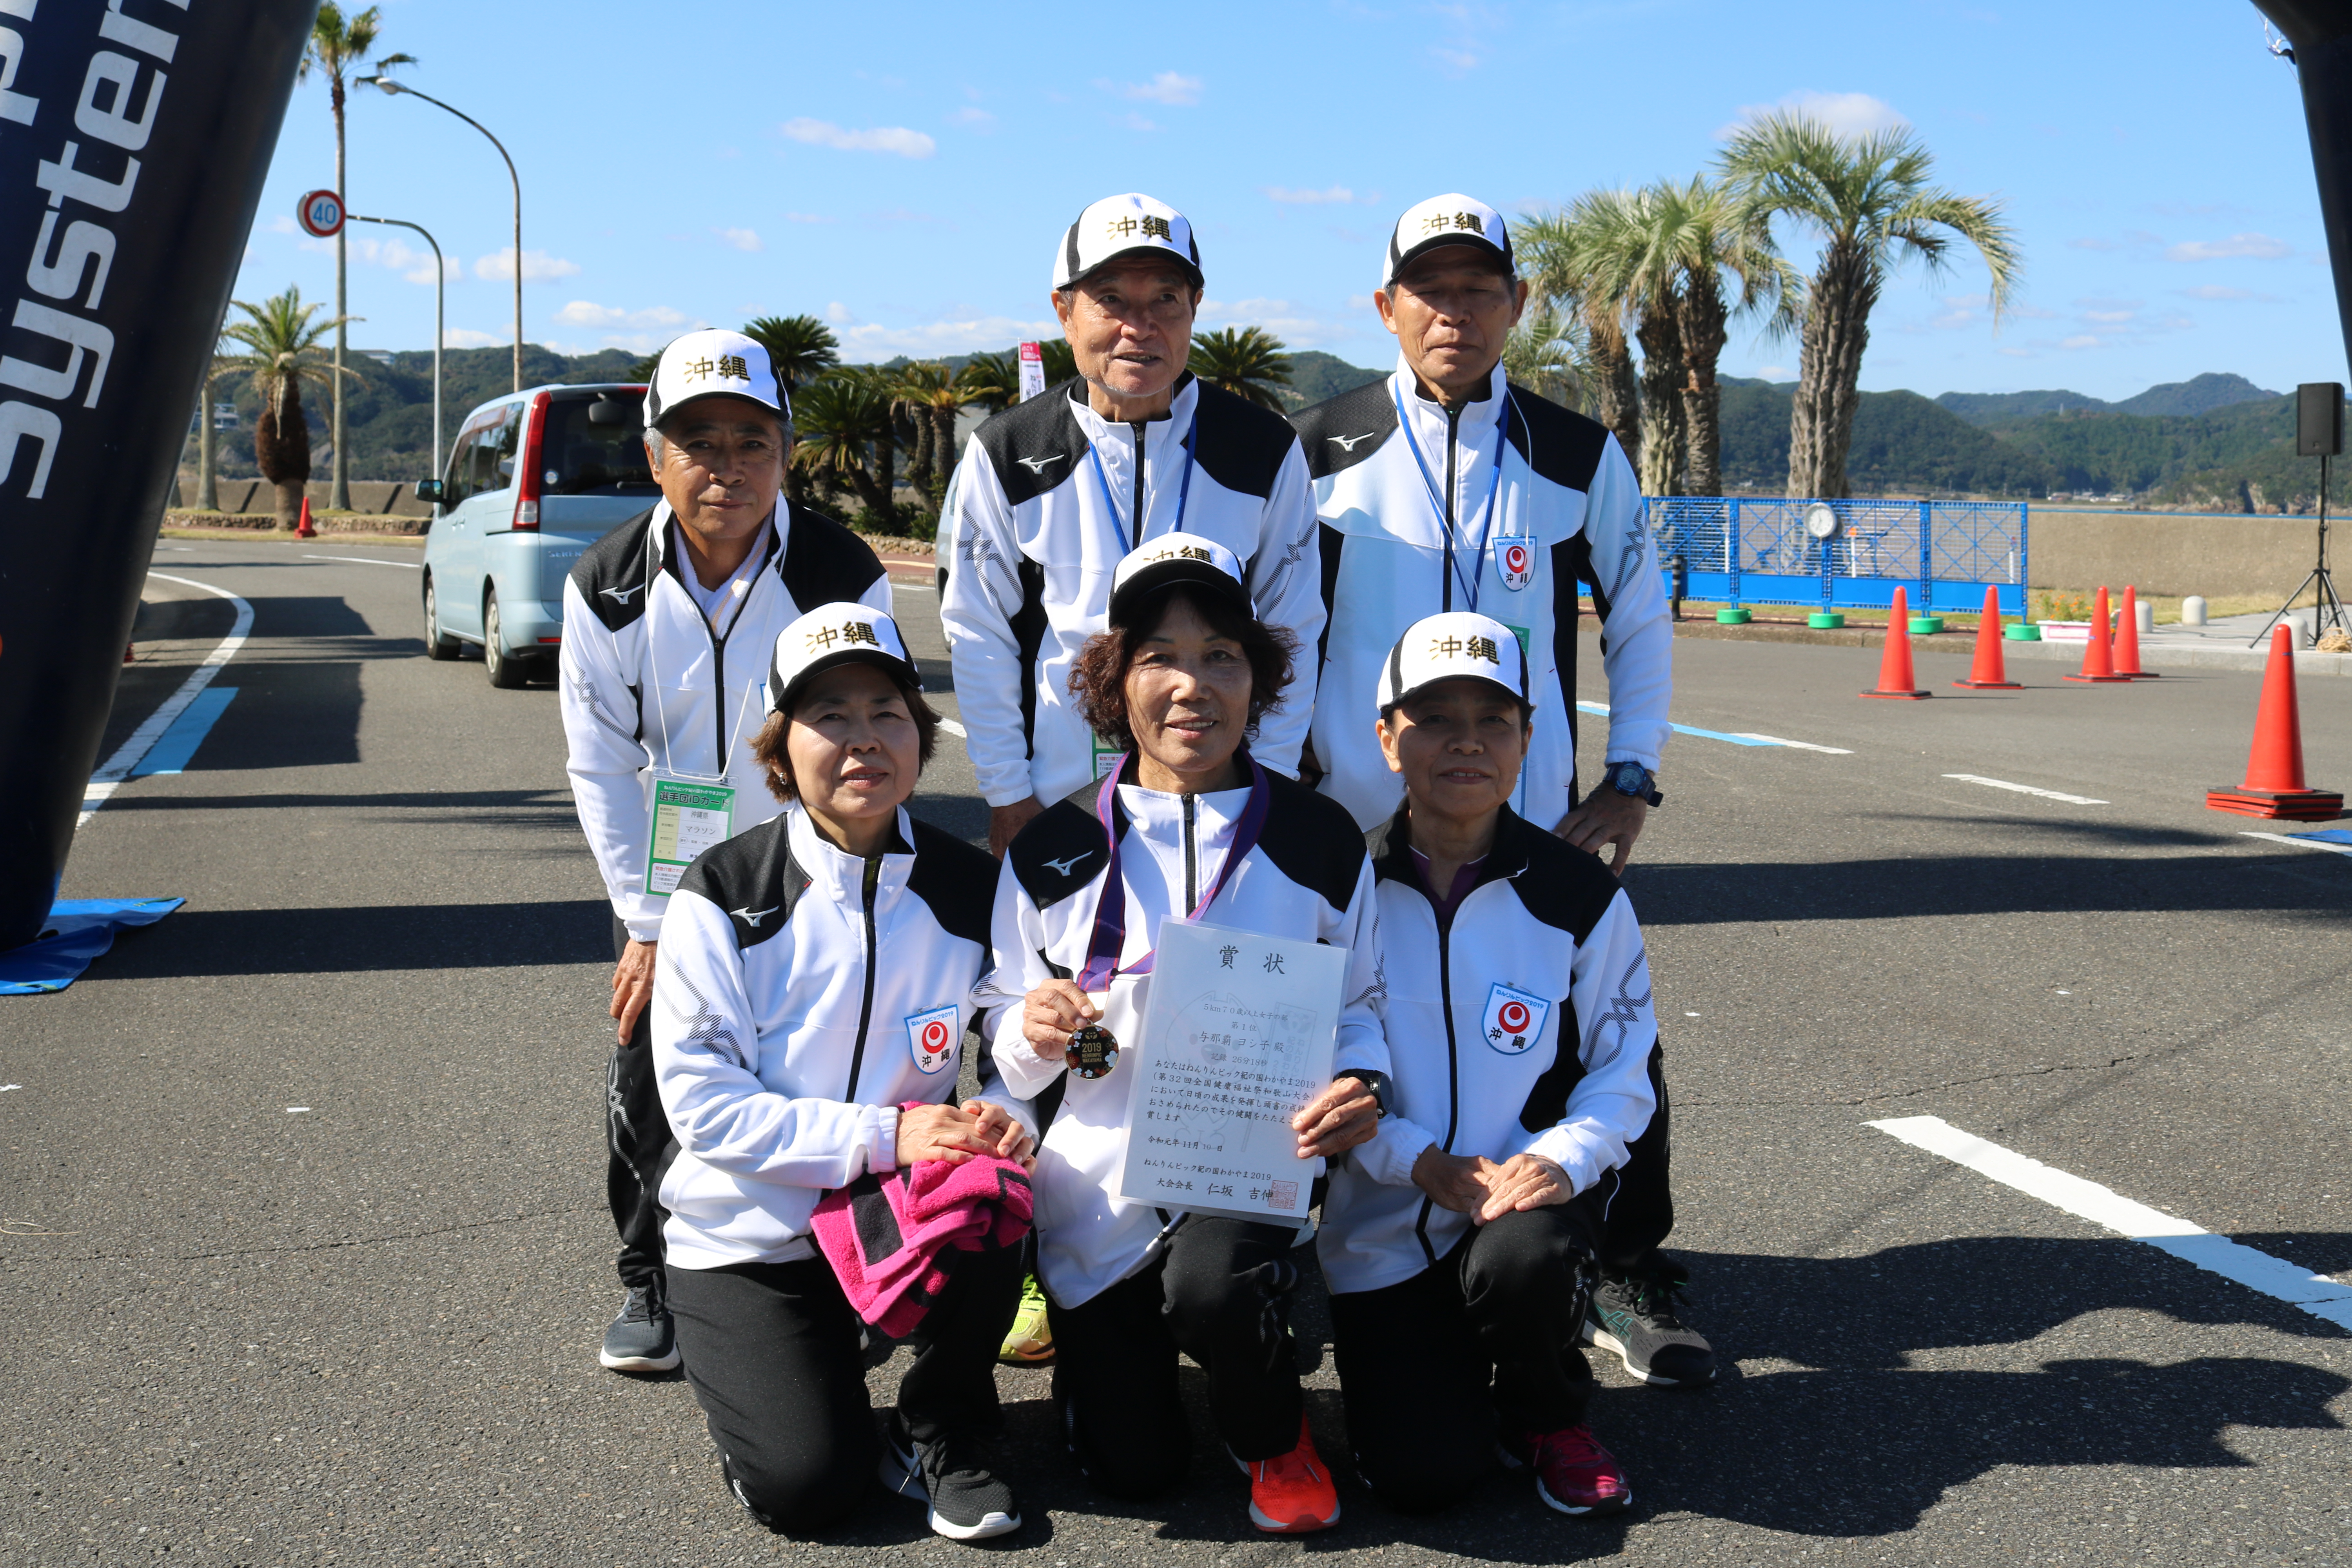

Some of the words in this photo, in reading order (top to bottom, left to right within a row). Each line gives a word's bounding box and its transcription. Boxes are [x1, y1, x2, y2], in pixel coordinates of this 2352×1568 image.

[313, 203, 336, 224] 40
[1421, 211, 1485, 235] 沖縄
[1107, 215, 1172, 243] 沖縄
[684, 354, 751, 383] 沖縄
[806, 621, 880, 654] 沖縄
[1430, 635, 1500, 666] 沖縄
[659, 791, 730, 808] 選手団IDカード
[685, 826, 716, 835] マラソン
[1496, 989, 1544, 1009] ねんりんピック2019
[911, 1011, 954, 1027] ねんりんピック2019
[1082, 1042, 1102, 1053] 2019
[1147, 1110, 1180, 1122] 賞します
[1144, 1158, 1271, 1180] ねんりんピック紀の国わかやま2019
[1156, 1178, 1193, 1191] 大会会長
